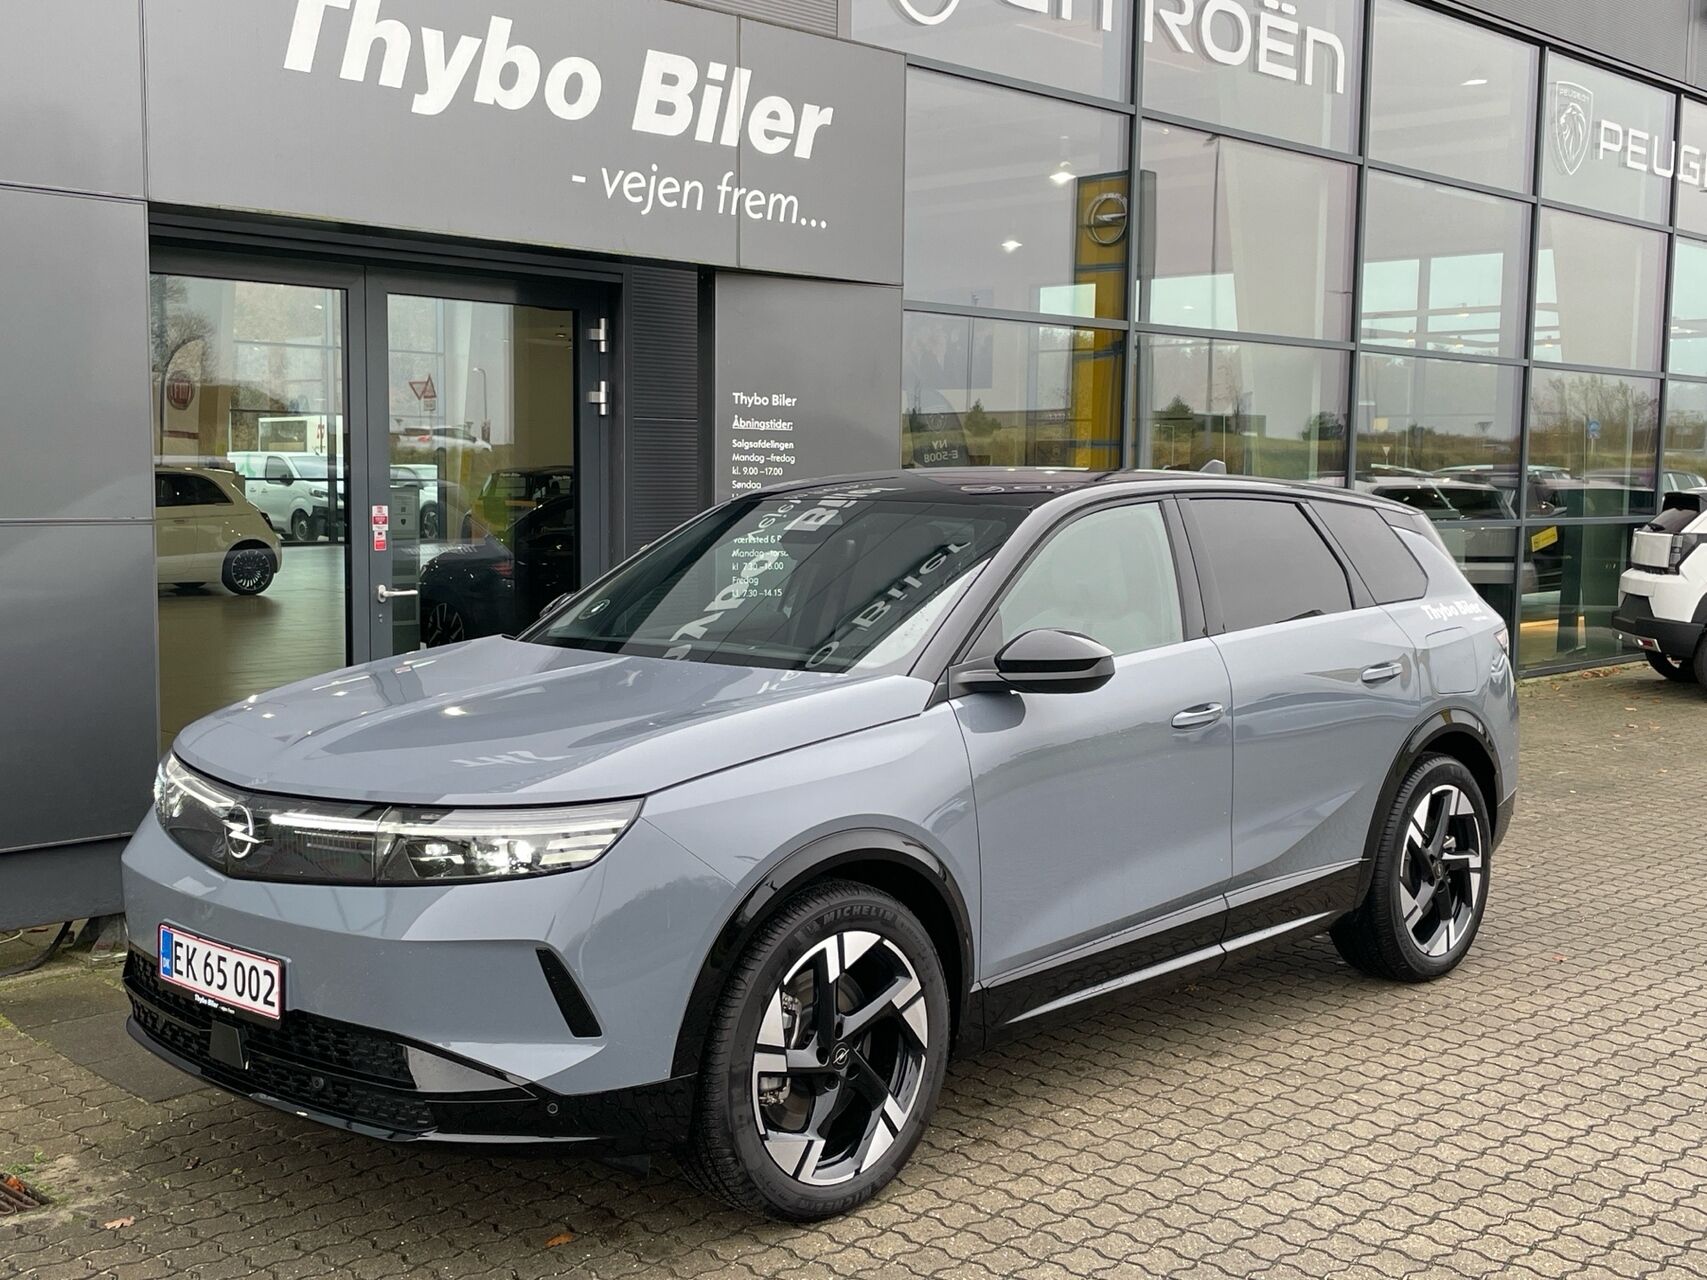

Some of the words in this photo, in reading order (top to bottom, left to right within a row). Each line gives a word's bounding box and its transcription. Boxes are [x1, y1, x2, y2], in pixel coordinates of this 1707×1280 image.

[284, 0, 601, 120] Thybo
[632, 49, 833, 159] Biler
[1599, 118, 1707, 188] PEUG
[601, 163, 704, 215] vejen
[717, 171, 827, 229] frem...
[732, 392, 768, 407] Thybo
[771, 393, 796, 406] Biler
[732, 439, 794, 450] Salgsafdelingen
[732, 453, 764, 463] Mandag
[742, 466, 758, 475] 9.00
[732, 576, 758, 585] Fredag
[823, 904, 896, 926] MICHELIN
[174, 941, 197, 982] EK
[203, 951, 227, 991] 65
[234, 961, 276, 1008] 002
